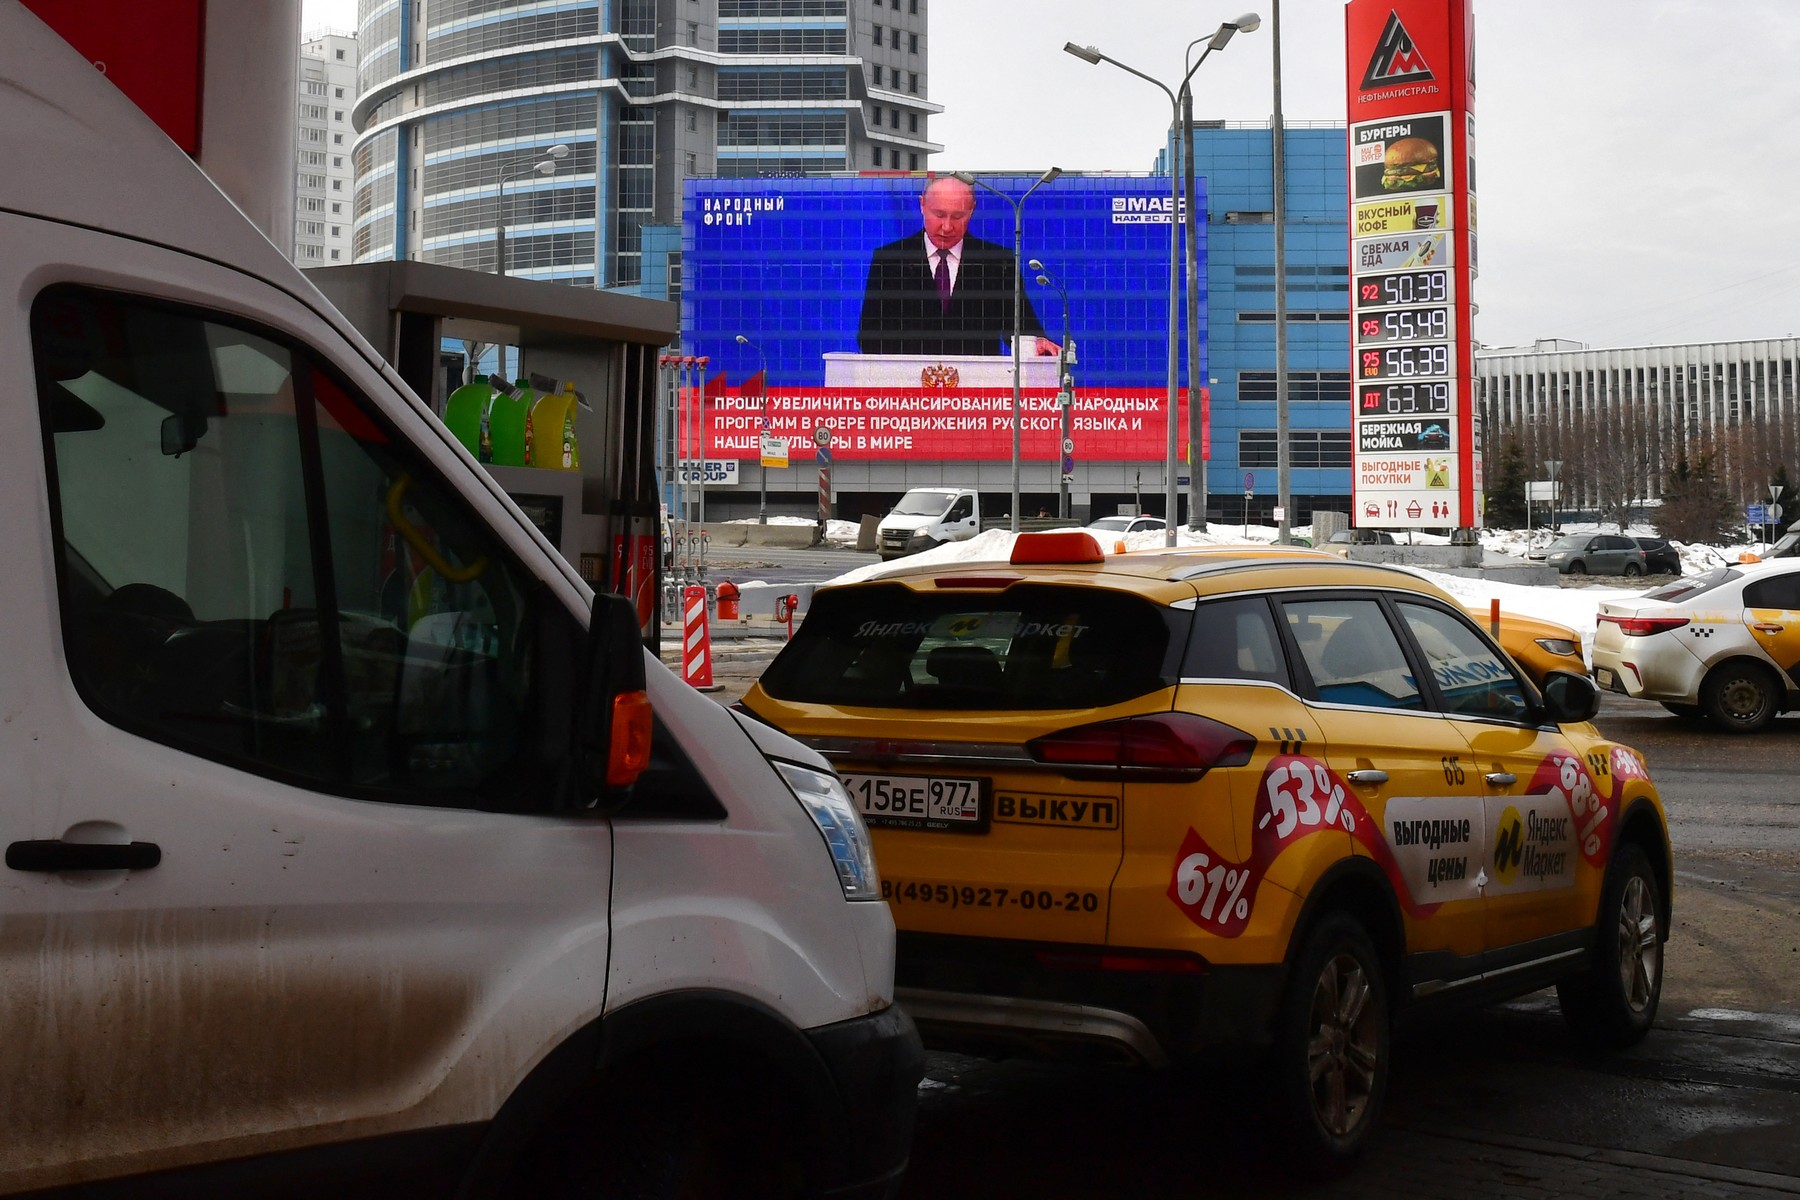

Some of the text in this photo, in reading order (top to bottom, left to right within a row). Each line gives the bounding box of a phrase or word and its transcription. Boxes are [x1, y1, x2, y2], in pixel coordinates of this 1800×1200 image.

[1358, 86, 1439, 103] НЕФТЬМАГИСТРАЛЬ
[1360, 124, 1411, 142] БУРГЕРЫ
[704, 196, 784, 212] НАРОДНЫЙ
[1358, 203, 1411, 221] ВКУСНЫЙ
[704, 213, 752, 226] ФРОНТ
[1359, 219, 1387, 233] КОФЕ
[1361, 241, 1409, 256] СВЕЖАЯ
[1361, 254, 1383, 268] ЕДА
[1362, 272, 1446, 304] 92 50.39
[1362, 309, 1447, 340] 95 55.49
[1363, 346, 1448, 377] 95 56.39
[1364, 367, 1378, 376] EVO
[773, 397, 861, 410] УВЕЛИЧИТЬ
[865, 397, 1012, 411] ФИНАНСИРОВАНИЕ
[1363, 383, 1448, 413] ДТ 63.79
[801, 416, 811, 429] В
[870, 417, 987, 432] ПРОДВИЖЕНИЯ
[1073, 417, 1128, 430] ЯЗЫКА
[1132, 417, 1142, 430] И
[1362, 422, 1422, 436] БЕРЕЖНАЯ
[714, 436, 762, 449] НАШЕ
[857, 436, 867, 449] В
[870, 436, 913, 449] МИРЕ
[818, 431, 829, 440] 80
[1362, 434, 1403, 449] МОЙКА
[1064, 442, 1072, 450] 80
[1362, 460, 1421, 473] ВЫГОДНЫЕ
[1362, 473, 1411, 485] ПОКУПКИ
[1441, 756, 1465, 786] 615
[931, 781, 972, 806] 977
[1258, 761, 1356, 839] -53%
[940, 806, 961, 816] RUS
[999, 796, 1113, 824] ВЫКУП
[926, 821, 949, 829] GEELY
[1526, 809, 1568, 846] Яндекс
[1393, 818, 1471, 850] выгодные
[1523, 845, 1566, 881] Маркет
[1427, 857, 1468, 888] цены
[1177, 853, 1250, 925] 61%
